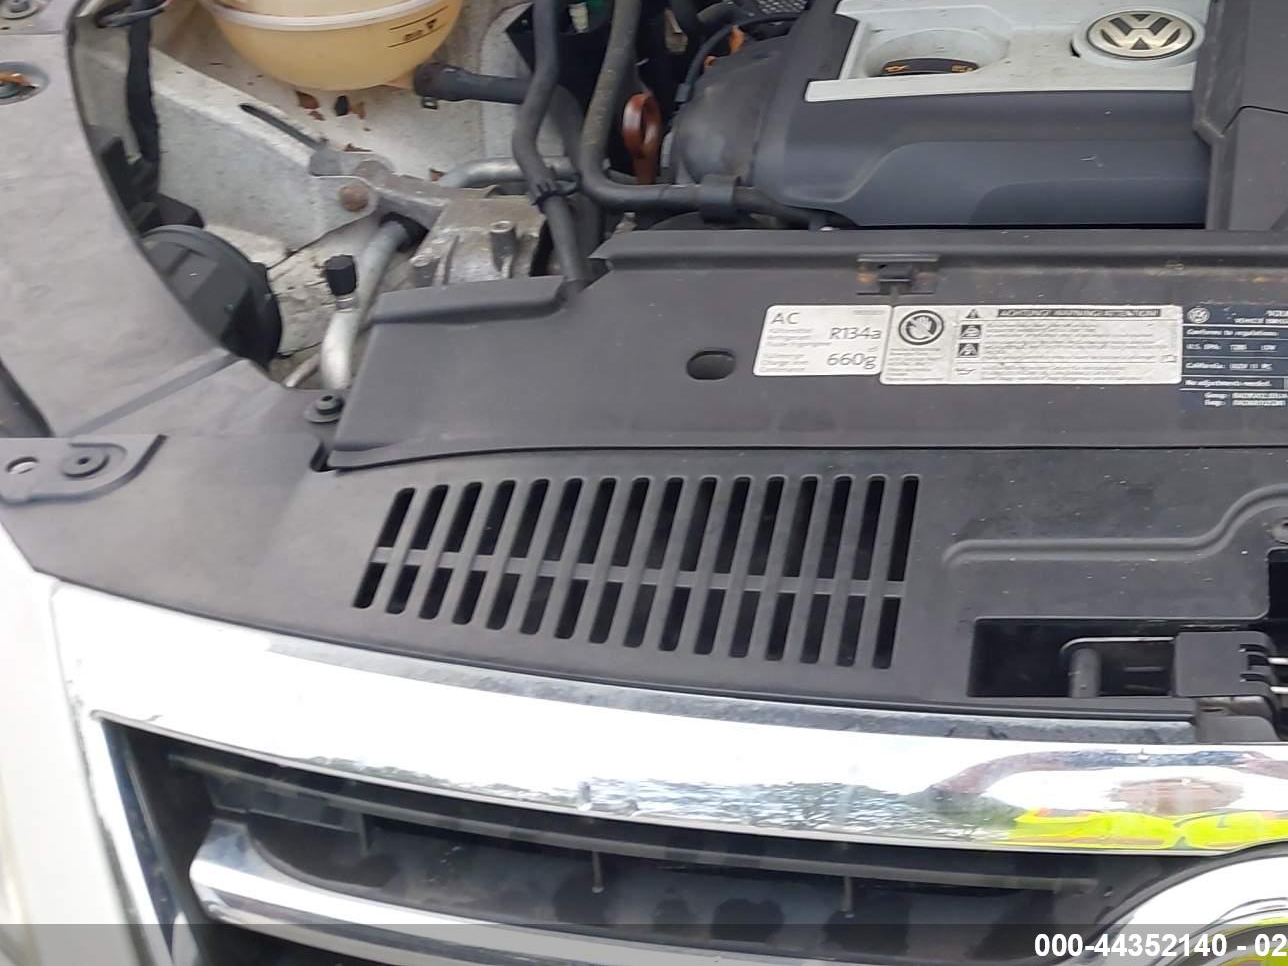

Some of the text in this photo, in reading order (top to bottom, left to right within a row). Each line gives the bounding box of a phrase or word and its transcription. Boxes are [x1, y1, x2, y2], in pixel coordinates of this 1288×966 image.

[1090, 11, 1192, 57] VW
[770, 312, 800, 324] AC
[829, 327, 882, 340] R134a
[826, 353, 877, 370] 660g
